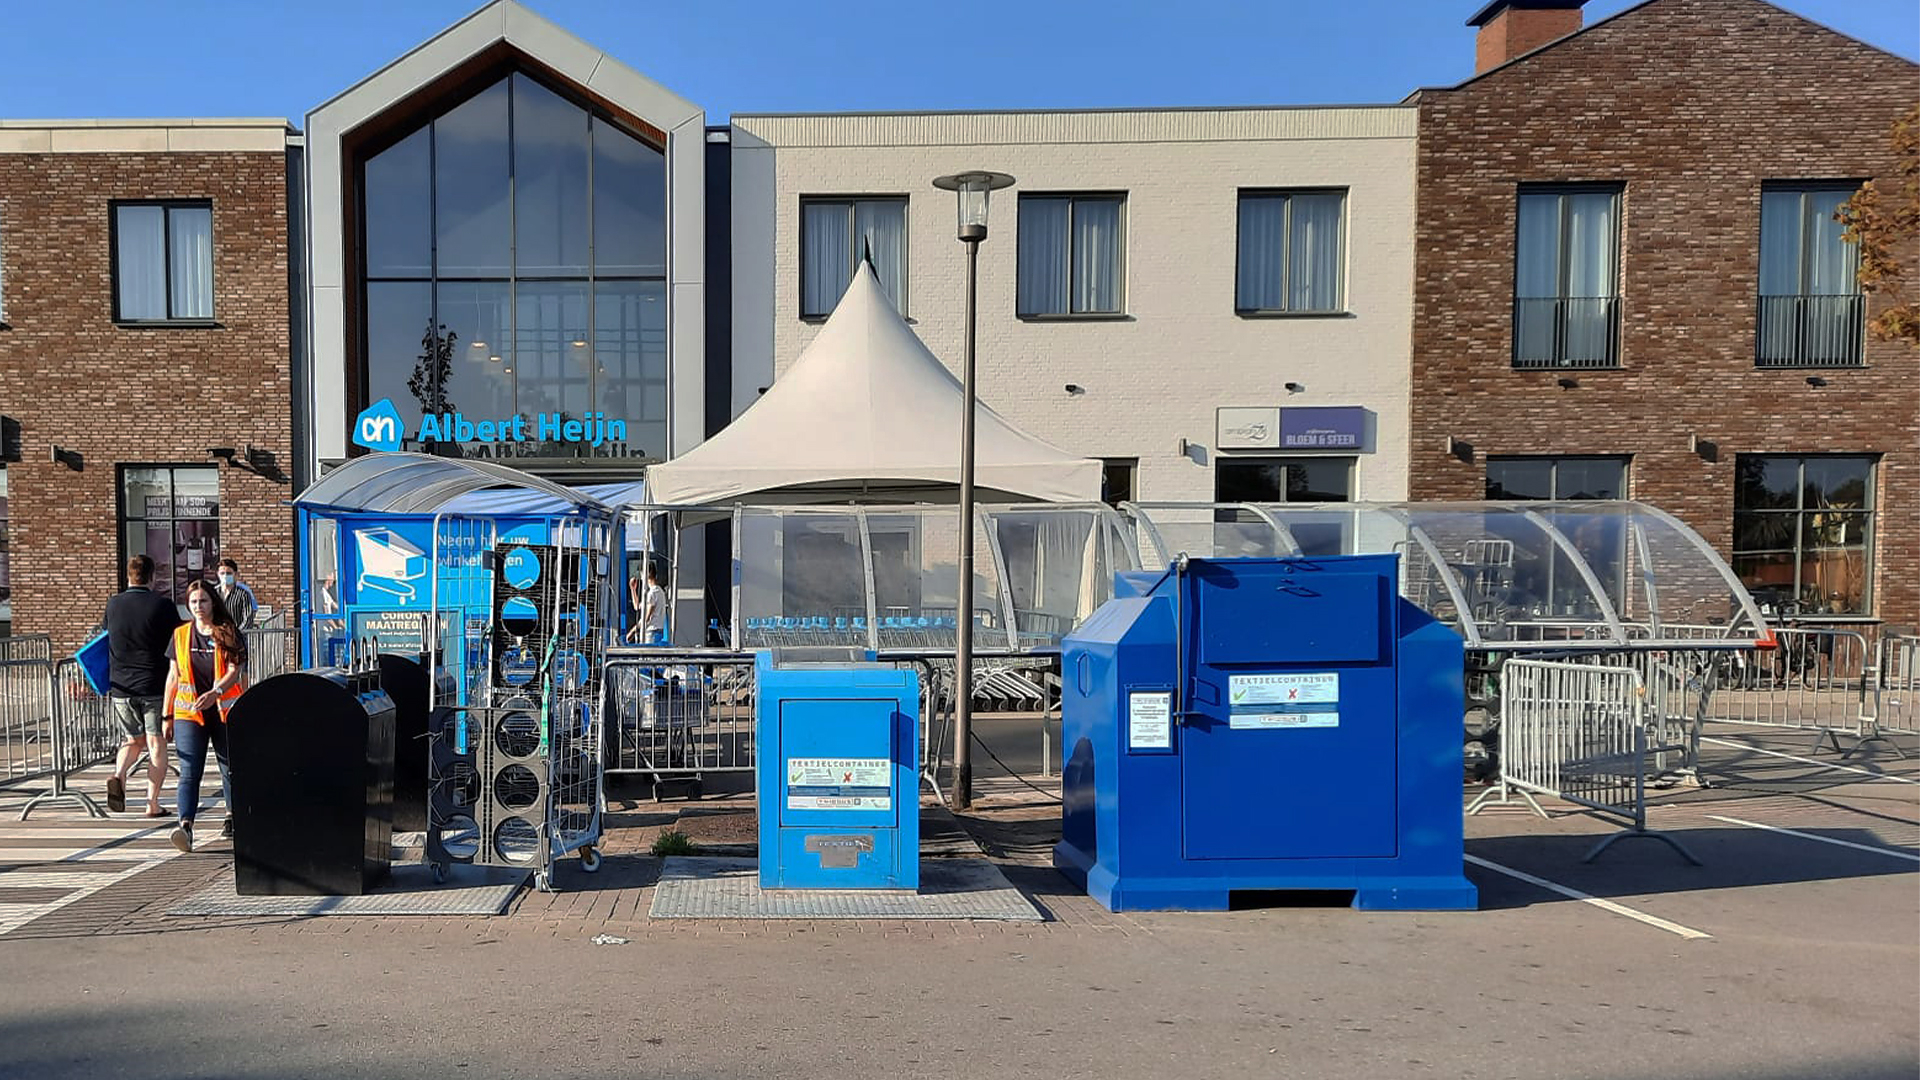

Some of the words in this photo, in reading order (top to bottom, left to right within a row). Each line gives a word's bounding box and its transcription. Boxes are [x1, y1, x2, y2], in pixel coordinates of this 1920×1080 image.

[418, 412, 525, 442] Albert
[539, 411, 627, 447] Heijn
[1286, 434, 1317, 445] BLOEM
[1328, 434, 1355, 445] SFEER
[189, 496, 206, 506] 500
[438, 534, 474, 547] Neem
[481, 534, 503, 547] hir
[381, 611, 430, 620] CORON
[366, 620, 447, 630] MAATREGN
[1233, 676, 1335, 685] TEXTIELCONTAINER
[792, 760, 887, 768] TEXTIELCONTAINER
